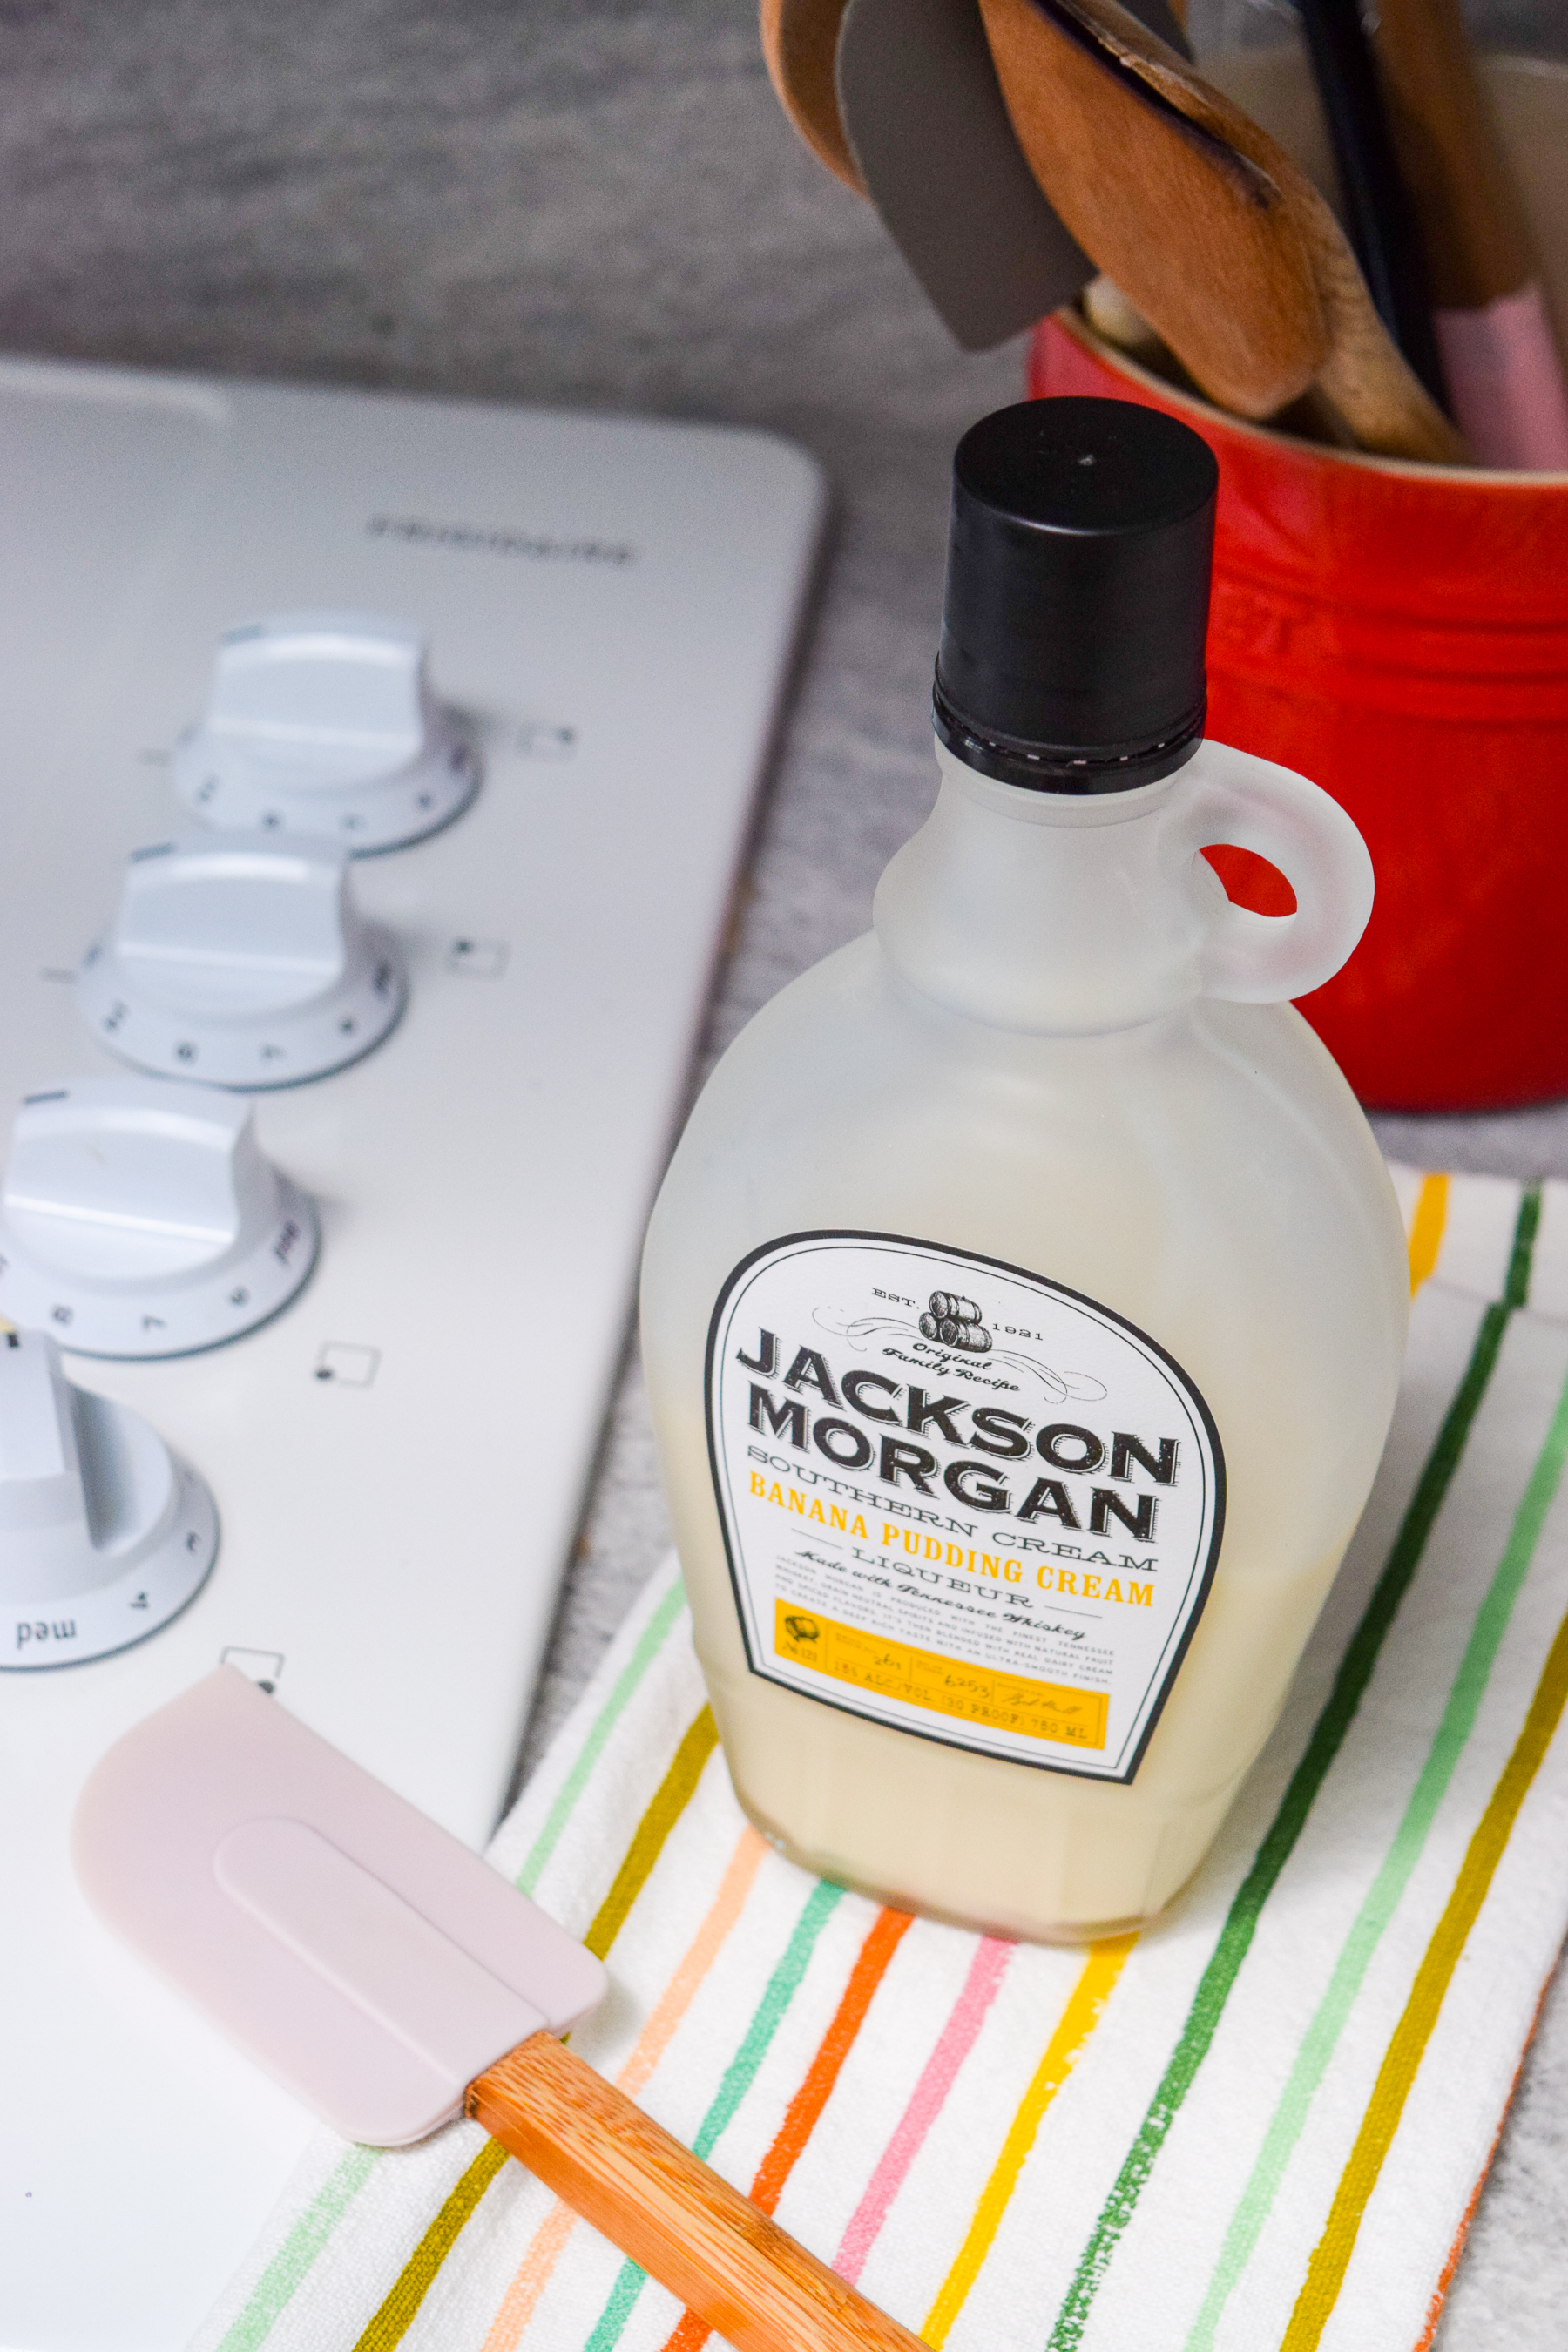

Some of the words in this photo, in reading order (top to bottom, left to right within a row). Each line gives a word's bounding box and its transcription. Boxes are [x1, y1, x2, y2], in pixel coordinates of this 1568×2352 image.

[871, 1287, 920, 1309] EST.
[991, 1322, 1044, 1341] 1921
[882, 1347, 950, 1376] Family
[953, 1368, 1021, 1392] Recipe
[912, 1342, 992, 1370] Original
[735, 1327, 1181, 1487] JACKSON
[747, 1382, 1159, 1542] MORGAN
[747, 1444, 979, 1537] SOUTHERN
[991, 1532, 1158, 1572] CREAM
[749, 1471, 869, 1540] BANANA
[882, 1522, 1022, 1584] PUDDING
[1037, 1565, 1154, 1607] CREAM
[795, 1551, 848, 1572] Made
[852, 1570, 893, 1588] with
[896, 1584, 997, 1618] Tennessee
[1003, 1612, 1085, 1640] Whiskey
[825, 1573, 864, 1592] MORGAN
[890, 1597, 941, 1616] PRODUCED
[950, 1614, 975, 1625] WITH
[985, 1623, 1003, 1632] THE
[1013, 1631, 1047, 1643] FINEST
[1058, 1639, 1114, 1656] TENNESSEE
[851, 1547, 1033, 1609] LIQUEUR
[16, 1619, 78, 1649] med
[798, 1582, 828, 1598] SPICED
[907, 1619, 931, 1633] THEN
[936, 1629, 980, 1646] BLENDED
[985, 1643, 1010, 1654] WITH
[1015, 1651, 1038, 1661] REAL
[1044, 1657, 1074, 1668] DAIRY
[1079, 1664, 1113, 1675] CREAM
[821, 1582, 848, 1596] GRAIN
[852, 1590, 894, 1612] NEUTRAL
[897, 1608, 934, 1624] SPIRITS
[937, 1619, 957, 1631] AND
[961, 1627, 1002, 1642] INFUSED
[1006, 1639, 1031, 1649] WITH
[1034, 1645, 1080, 1660] NATURAL
[1085, 1655, 1114, 1666] FRUIT
[899, 1627, 931, 1642] TASTE
[936, 1639, 962, 1651] WITH
